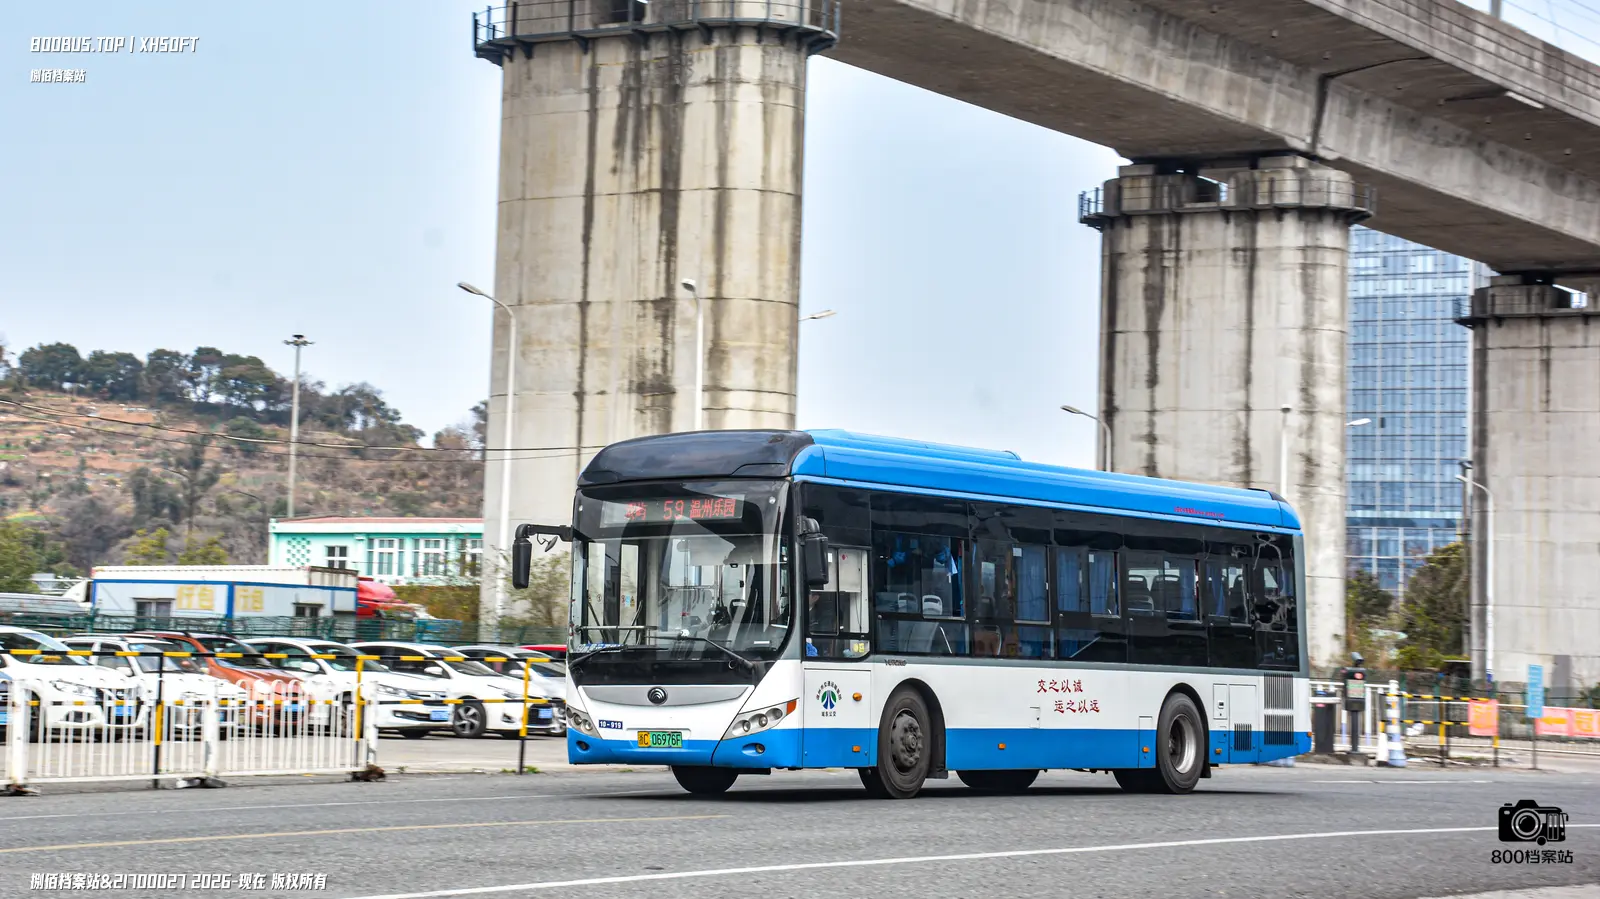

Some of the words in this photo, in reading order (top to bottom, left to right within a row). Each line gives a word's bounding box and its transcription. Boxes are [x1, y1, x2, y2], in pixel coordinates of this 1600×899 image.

[663, 499, 685, 520] 59
[689, 498, 737, 519] 温州乐园
[1037, 679, 1083, 693] 交之以诚
[1054, 699, 1100, 714] 运之以远
[600, 720, 622, 729] 10-919
